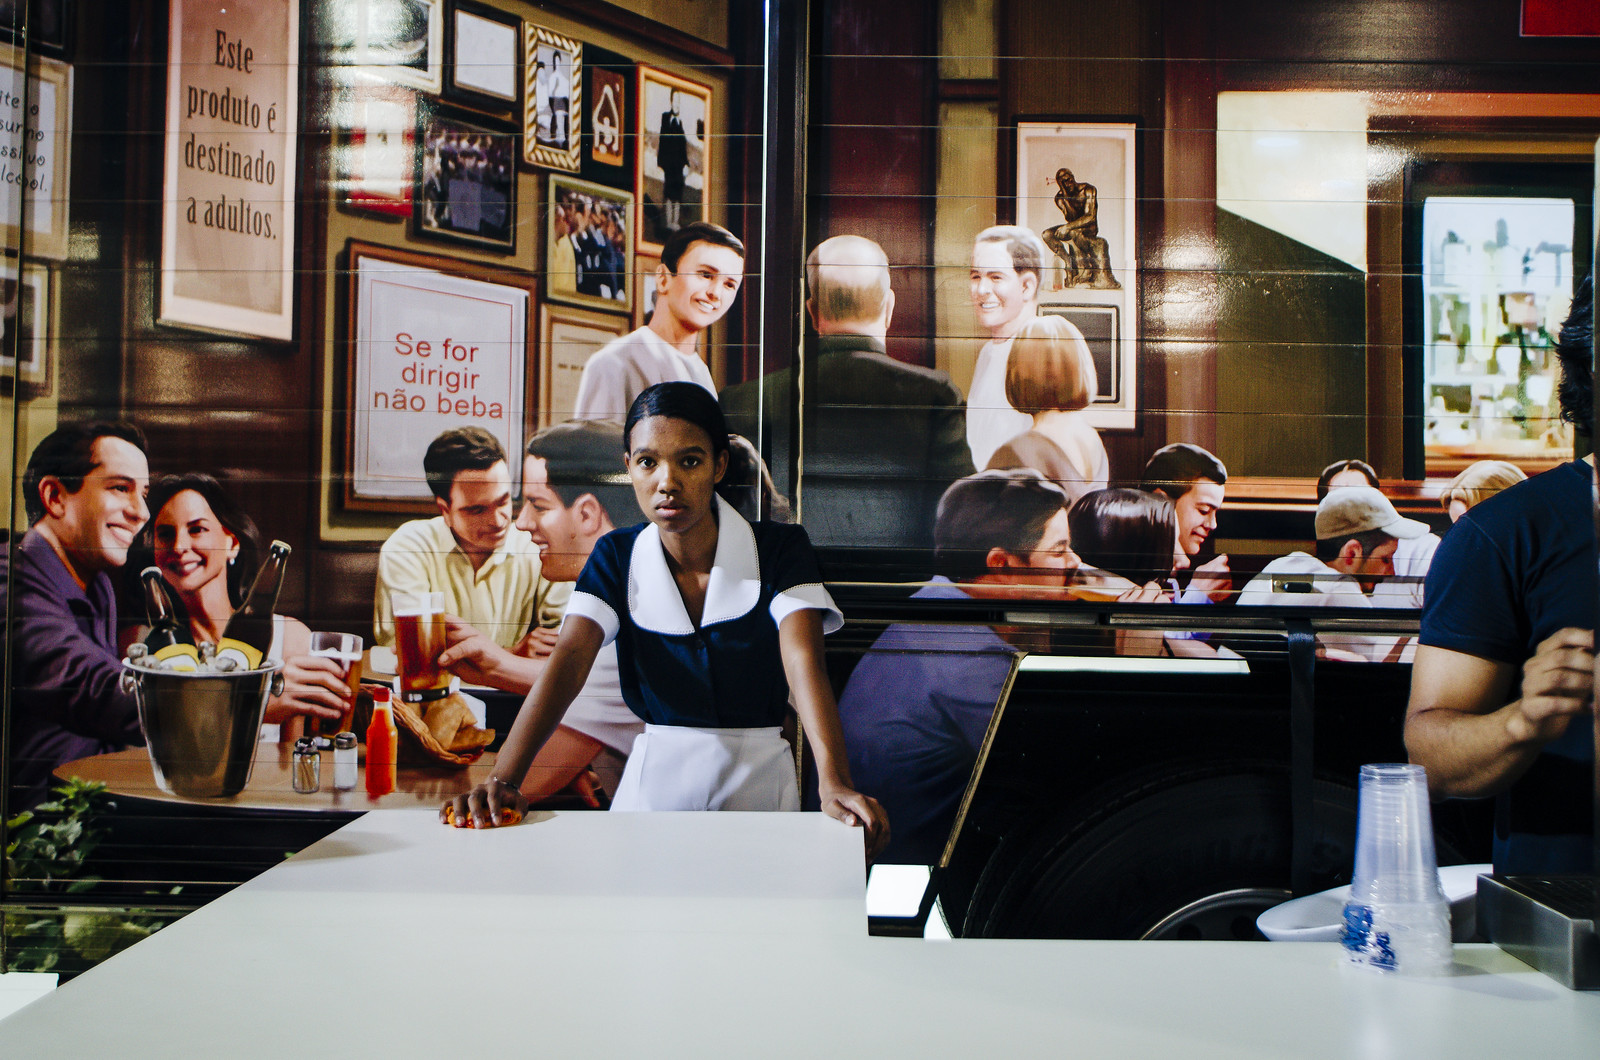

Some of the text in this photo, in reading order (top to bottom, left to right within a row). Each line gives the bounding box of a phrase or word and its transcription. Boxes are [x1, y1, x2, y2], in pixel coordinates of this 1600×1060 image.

[214, 28, 254, 74] Este
[30, 103, 40, 115] o
[187, 84, 277, 133] produto é
[185, 132, 275, 185] destinado
[187, 194, 277, 240] a adultos.
[395, 332, 479, 362] Se for
[401, 361, 480, 394] dirigir
[374, 388, 503, 419] não beba
